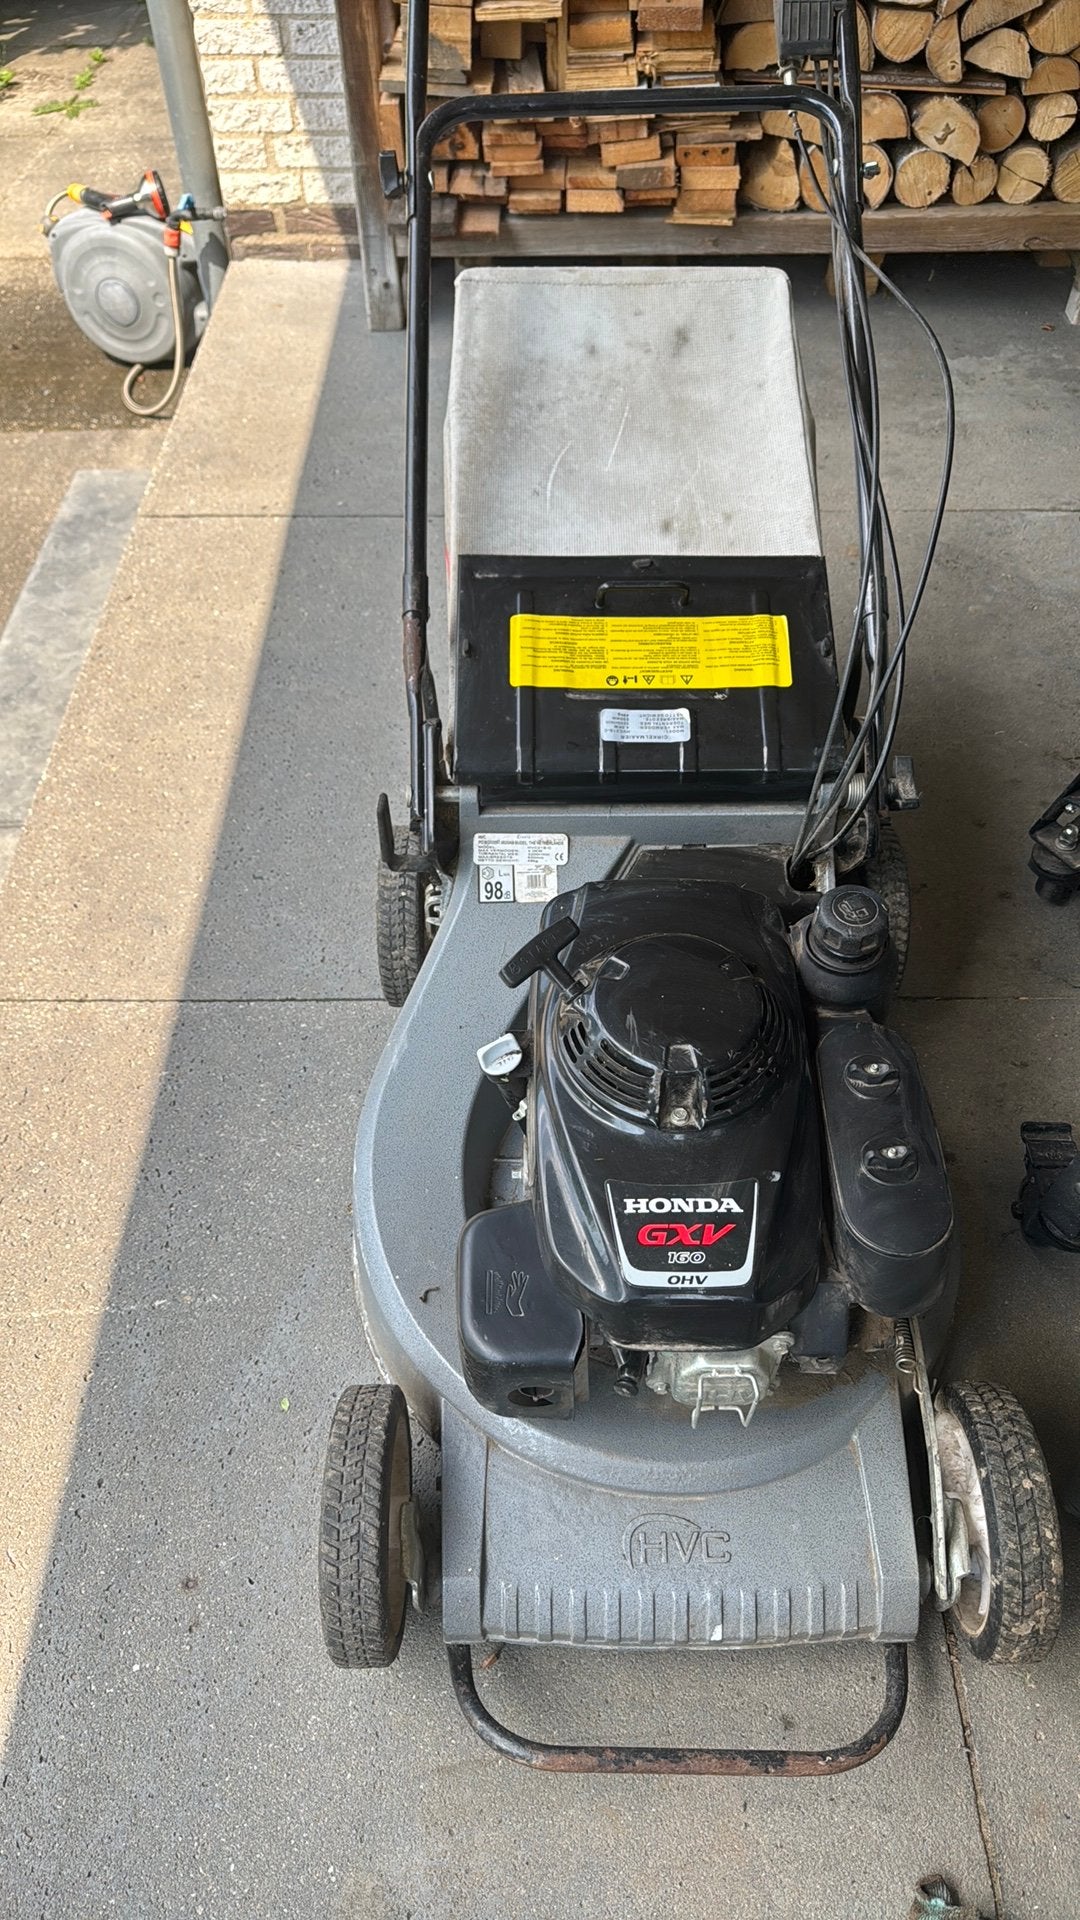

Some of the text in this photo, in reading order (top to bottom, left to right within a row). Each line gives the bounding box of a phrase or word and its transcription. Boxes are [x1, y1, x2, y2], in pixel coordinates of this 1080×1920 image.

[484, 881, 503, 900] 98
[623, 1197, 744, 1214] HONDA
[636, 1222, 737, 1247] GXV
[667, 1251, 706, 1264] 160
[667, 1275, 709, 1285] OHV
[637, 1529, 732, 1565] HVC
